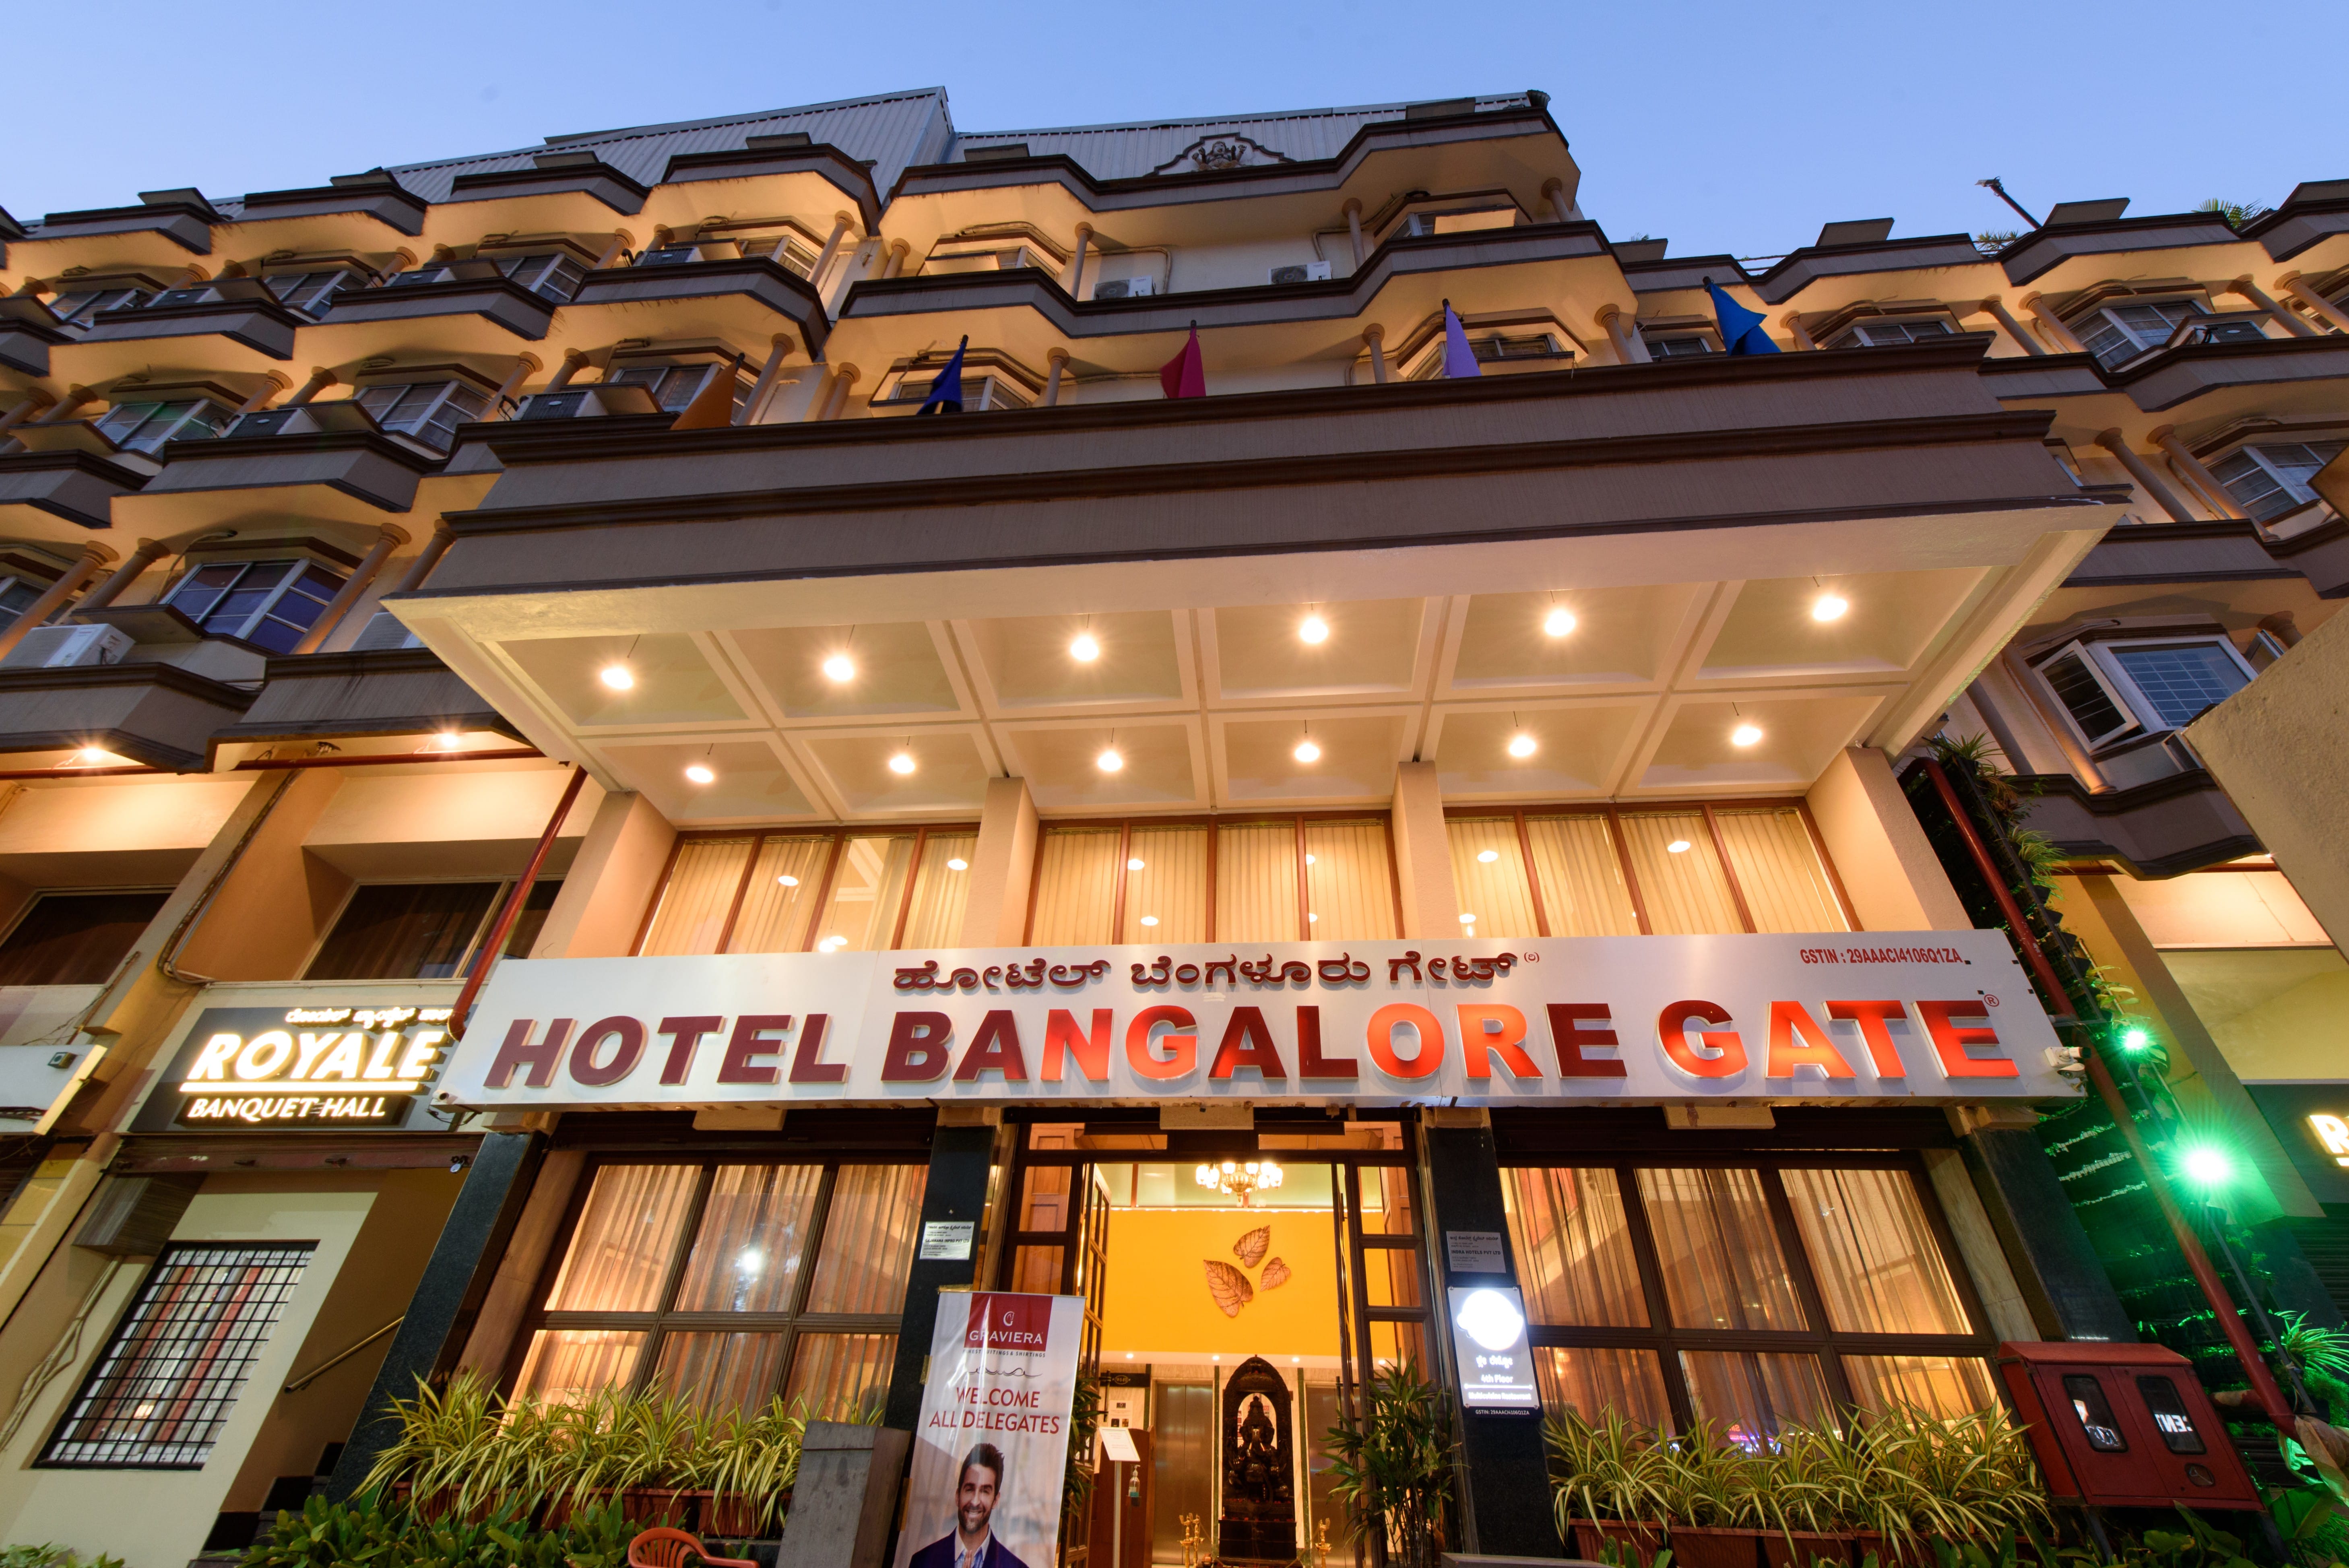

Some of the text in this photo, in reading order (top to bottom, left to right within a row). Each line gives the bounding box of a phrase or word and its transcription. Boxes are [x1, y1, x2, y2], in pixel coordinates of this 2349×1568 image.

[1800, 949, 1839, 963] GSTIN
[1847, 948, 1963, 964] 29AAACI4106Q1ZA
[893, 958, 1111, 990] ಹೋಟೆಲ್
[1131, 952, 1371, 986] ಬೆಂಗಳೂರು
[1387, 951, 1518, 982] ಗೇಟ್
[187, 1031, 446, 1080] ROYALE
[483, 1013, 851, 1088] HOTEL
[881, 1003, 1628, 1083] BANGALORE
[1656, 1000, 2020, 1079] GATE
[188, 1097, 386, 1121] BANQUET HALL
[969, 1330, 1042, 1344] GRAVIERA
[956, 1387, 1040, 1408] WELCOME
[929, 1410, 1060, 1434] ALL DELEGATES
